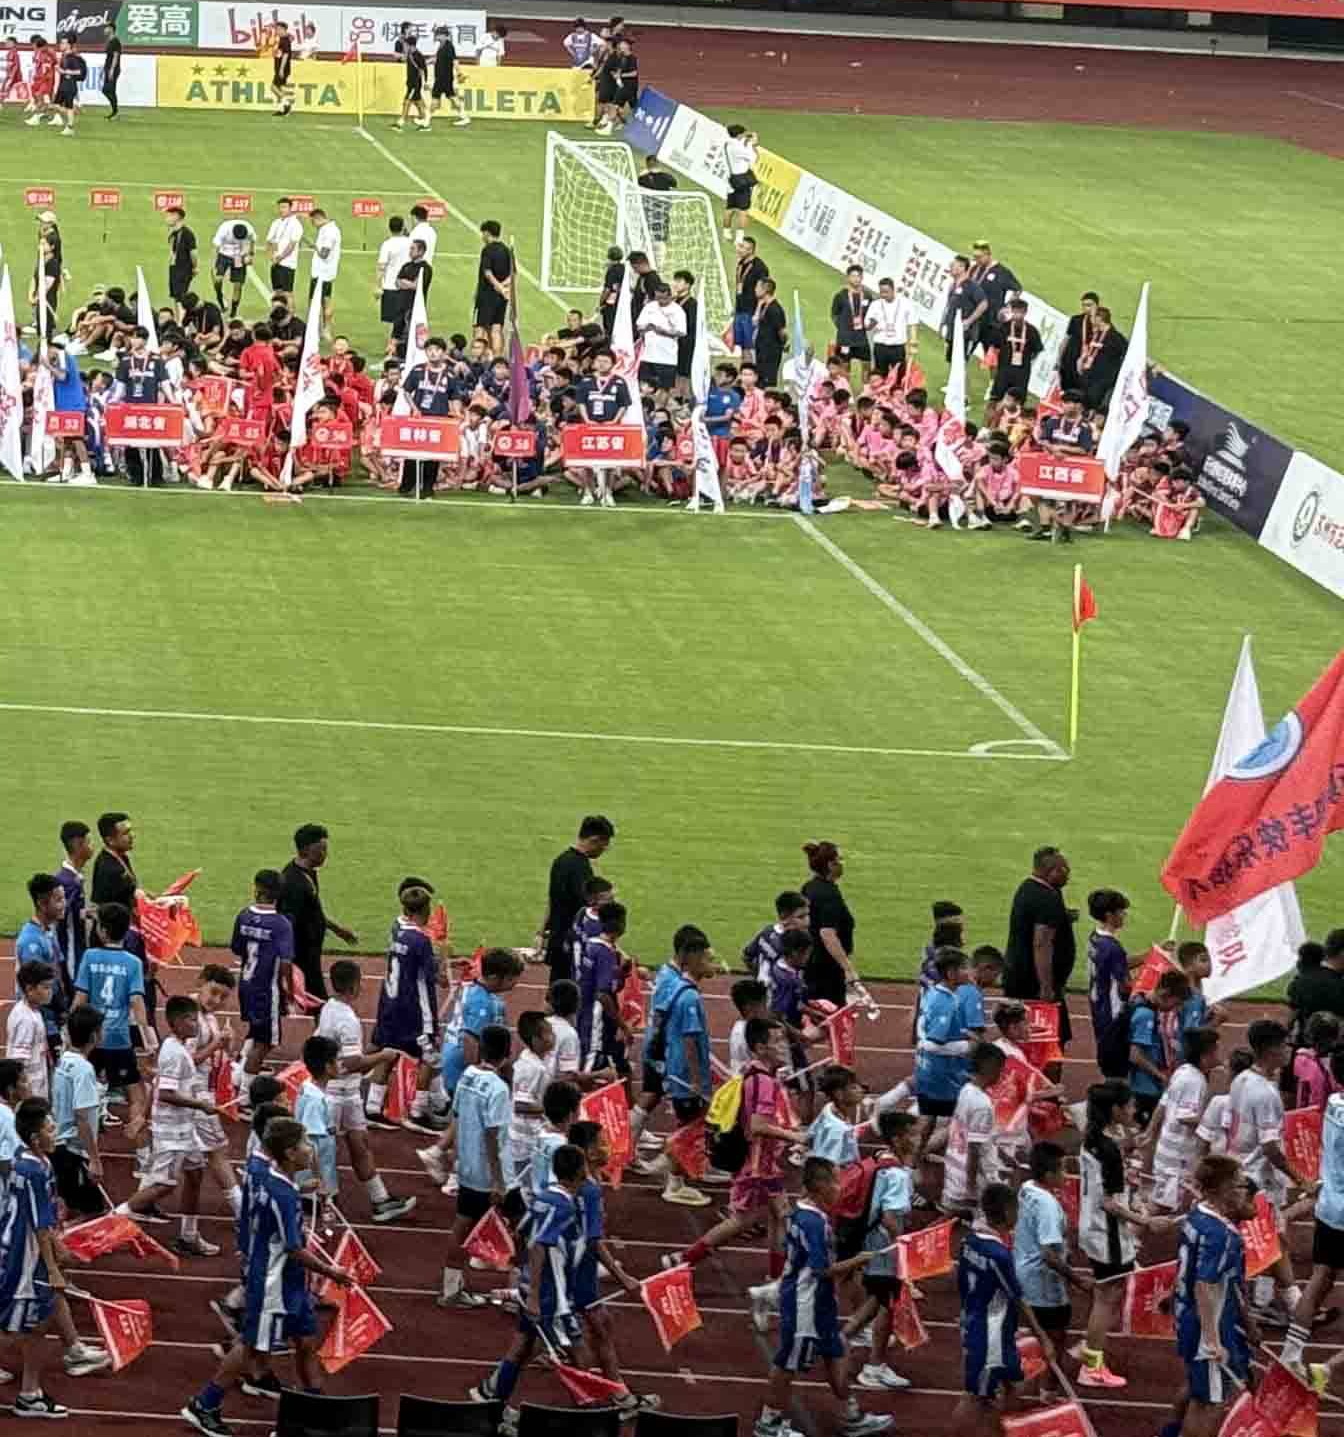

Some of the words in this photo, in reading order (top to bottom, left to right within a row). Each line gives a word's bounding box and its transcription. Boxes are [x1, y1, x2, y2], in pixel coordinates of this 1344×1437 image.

[126, 3, 191, 34] 爱高
[581, 435, 625, 452] 江苏省
[1038, 465, 1086, 483] 江西省
[100, 975, 115, 1006] 4
